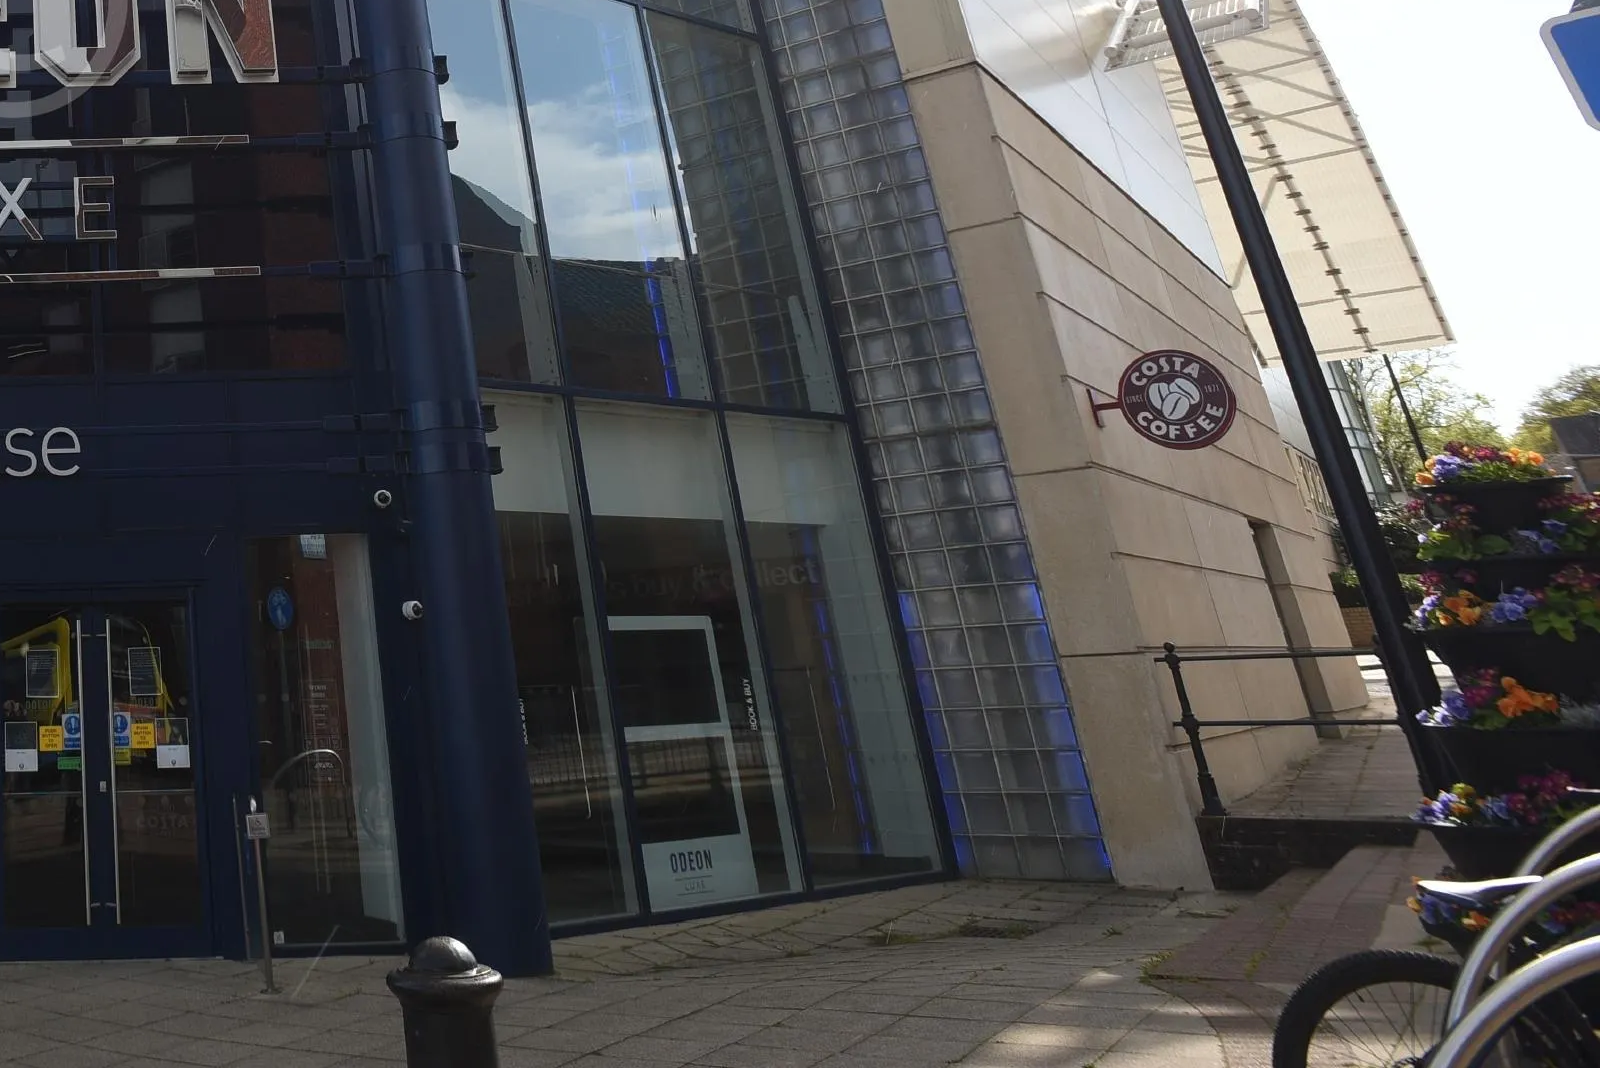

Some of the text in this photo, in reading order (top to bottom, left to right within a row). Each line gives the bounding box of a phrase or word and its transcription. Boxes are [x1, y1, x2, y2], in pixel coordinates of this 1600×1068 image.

[1131, 356, 1200, 386] COSTA
[1137, 403, 1224, 440] COFFEE
[719, 557, 822, 591] cllect
[741, 678, 752, 696] BUY
[747, 705, 758, 731] BOOK
[670, 849, 713, 873] ODEON
